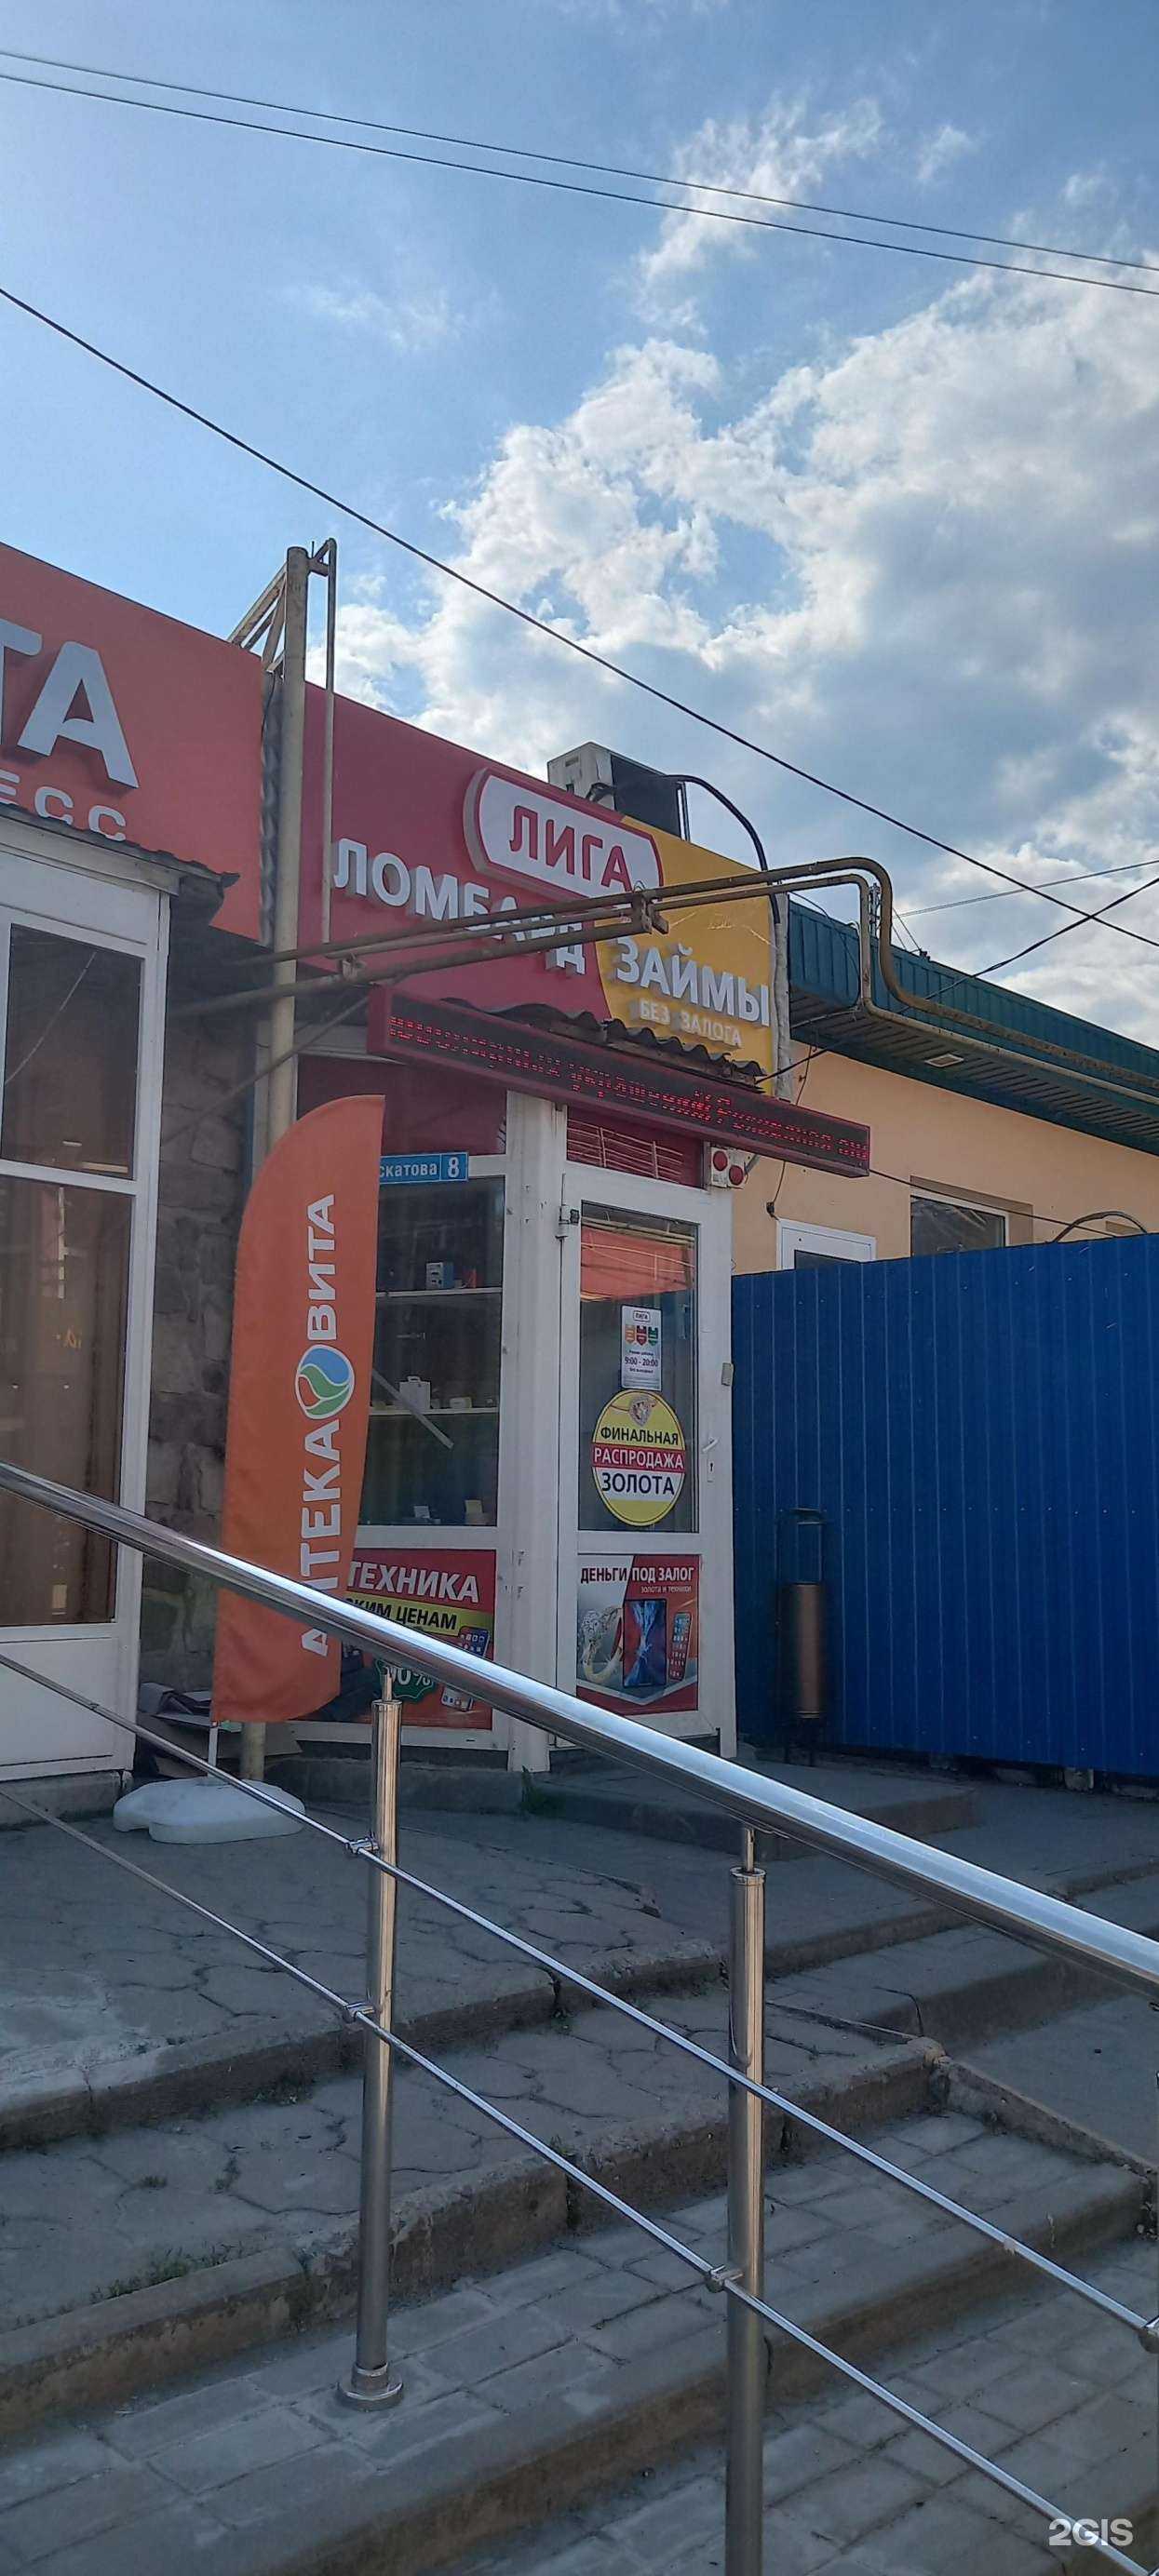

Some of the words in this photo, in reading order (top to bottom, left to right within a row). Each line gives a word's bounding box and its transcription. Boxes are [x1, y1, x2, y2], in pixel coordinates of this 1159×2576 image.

[509, 805, 633, 892] ЛИГА
[616, 935, 770, 1027] ЗАЙМЫ
[640, 999, 670, 1025] БЕЗ
[680, 1011, 742, 1049] ЗАЛОГА
[448, 1157, 460, 1178] 8
[306, 1194, 338, 1341] ВИТА
[600, 1426, 679, 1445] ФИНАЛЬНАЯ
[594, 1447, 684, 1469] РАСПРОДАЖА
[601, 1472, 675, 1496] ЗОЛОТА
[347, 1561, 480, 1603] ТЕХНИКА
[581, 1567, 627, 1584] ДЕНЬГИ
[632, 1567, 655, 1583] ПОД
[658, 1567, 694, 1582] ЗАЛОГ
[396, 1605, 458, 1630] ЦЕНАМ
